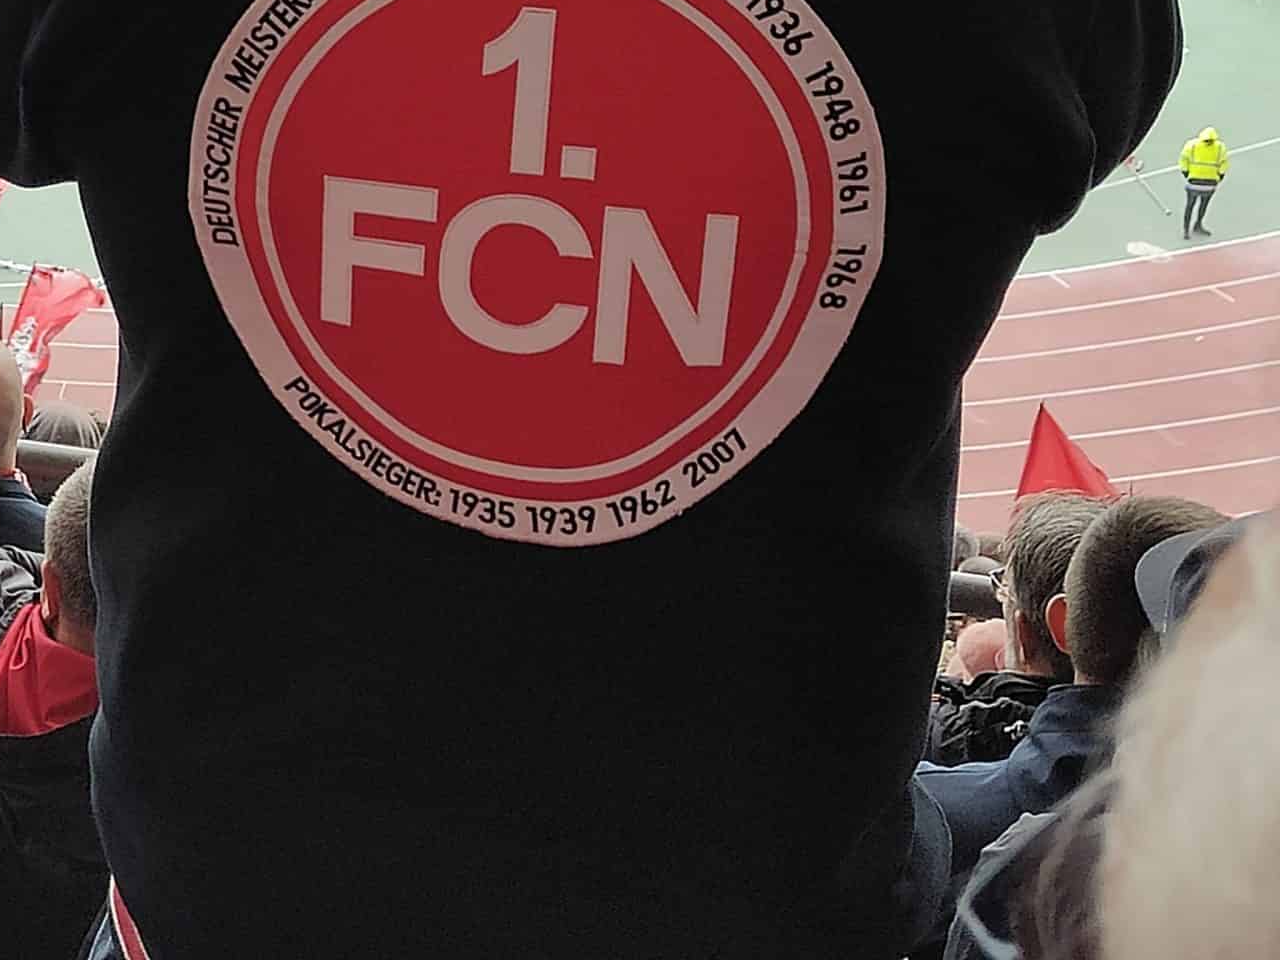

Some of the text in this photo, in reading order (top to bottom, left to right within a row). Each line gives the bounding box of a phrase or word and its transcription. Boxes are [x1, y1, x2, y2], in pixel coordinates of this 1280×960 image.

[481, 6, 598, 181] 1.
[805, 61, 861, 141] 1948
[203, 96, 243, 247] DEUTSCHER
[836, 151, 871, 215] 1961
[320, 173, 740, 368] FCN
[819, 243, 867, 310] 1968
[283, 375, 748, 535] POKALSIEGER: 1935 1939 1962 2007
